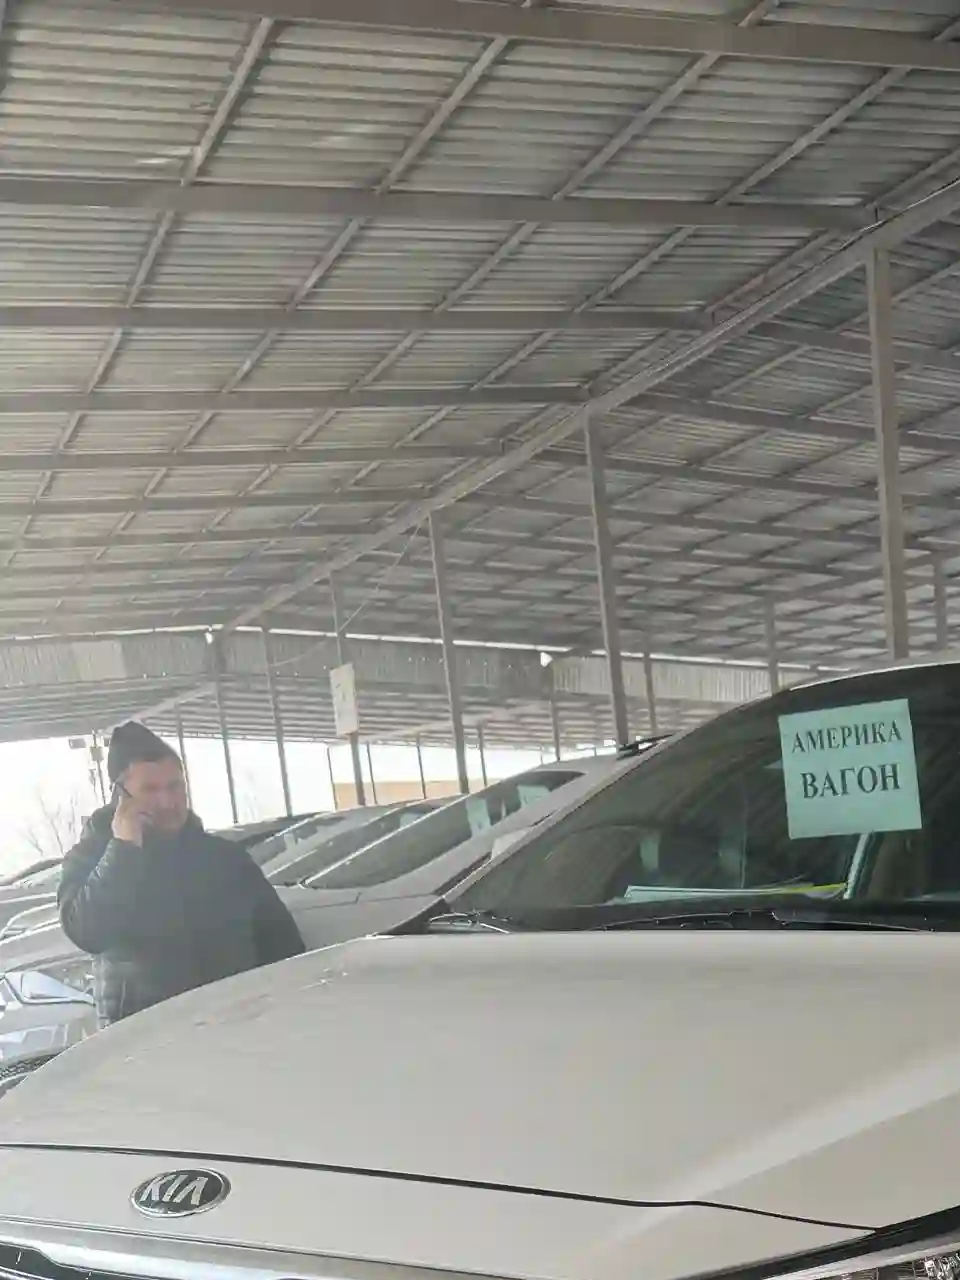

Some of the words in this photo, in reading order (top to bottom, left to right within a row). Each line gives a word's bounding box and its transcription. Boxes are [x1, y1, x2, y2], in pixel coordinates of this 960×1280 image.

[791, 720, 902, 754] АМЕРИКА
[800, 762, 901, 799] ВАГОН
[137, 1171, 212, 1208] KIA
